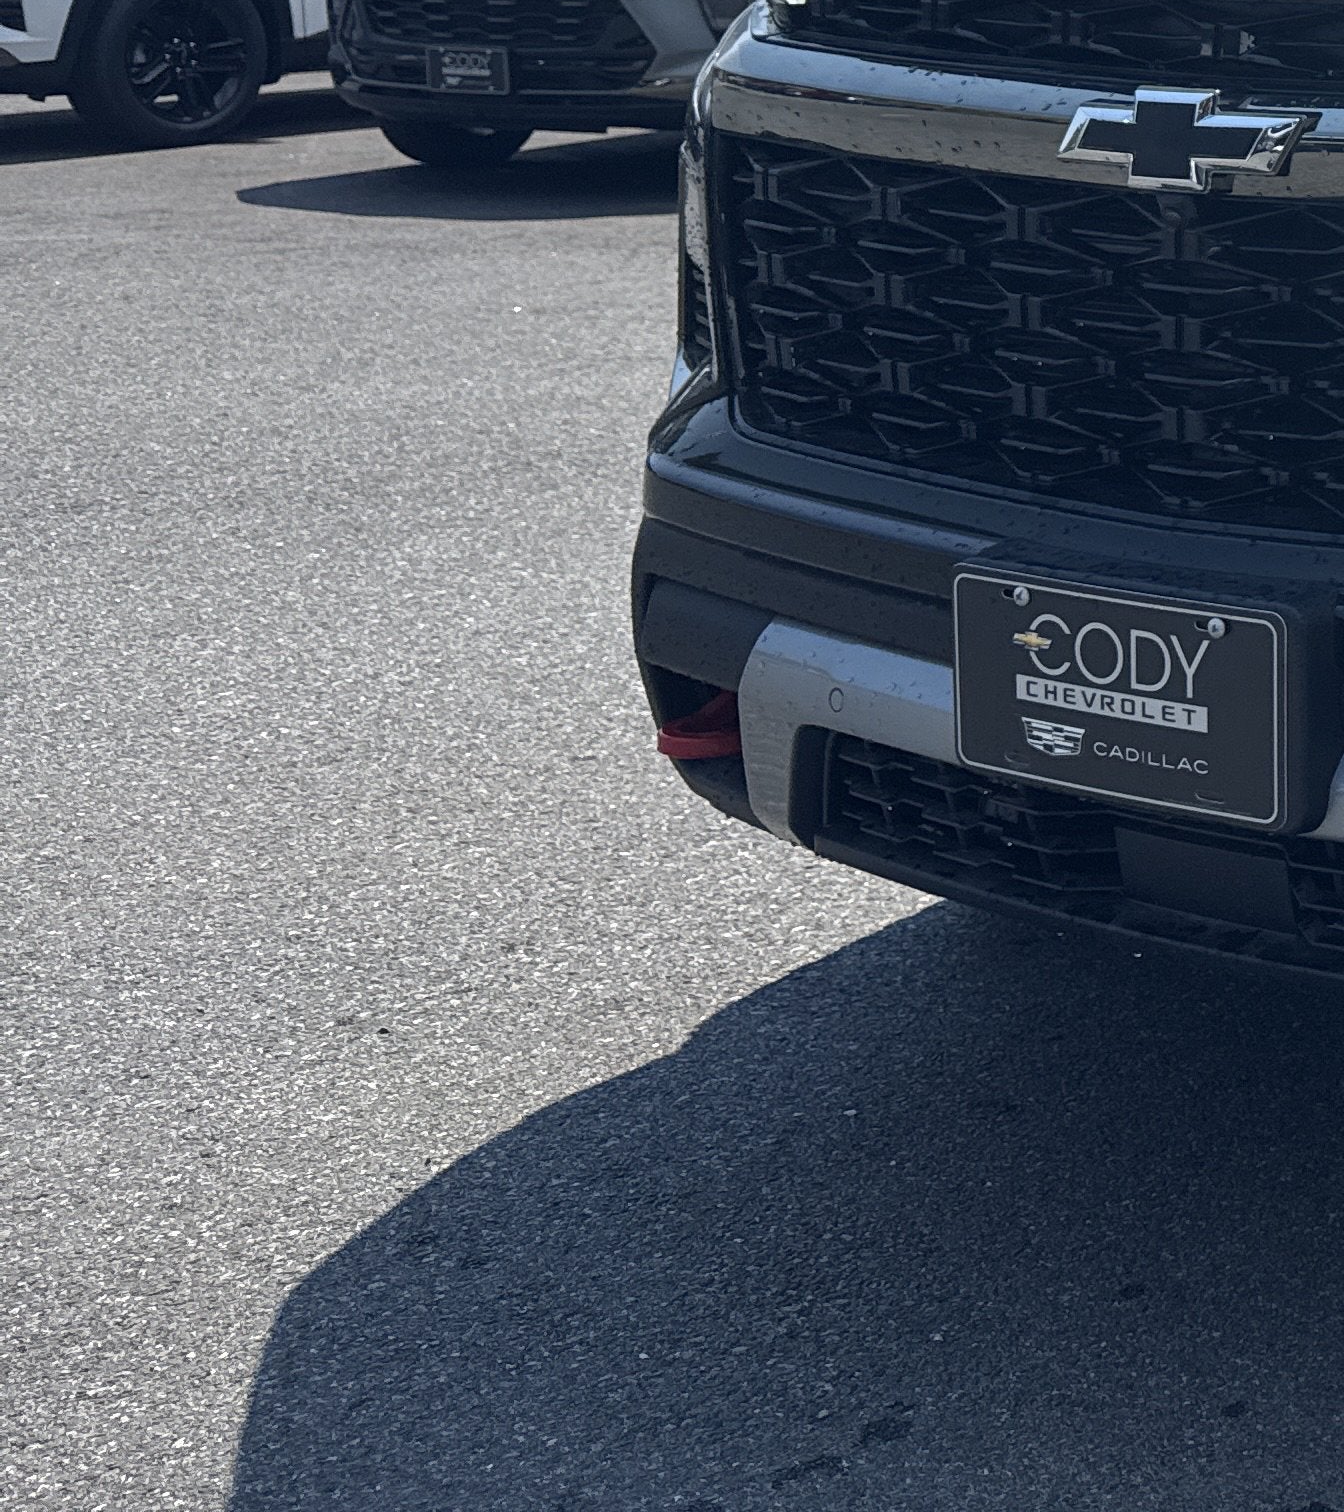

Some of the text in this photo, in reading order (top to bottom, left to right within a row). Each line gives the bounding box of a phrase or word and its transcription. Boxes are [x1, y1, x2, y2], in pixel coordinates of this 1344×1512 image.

[1029, 613, 1209, 699] CODY
[1025, 679, 1198, 727] CHEVROLET
[1093, 740, 1210, 775] CADILLAC
